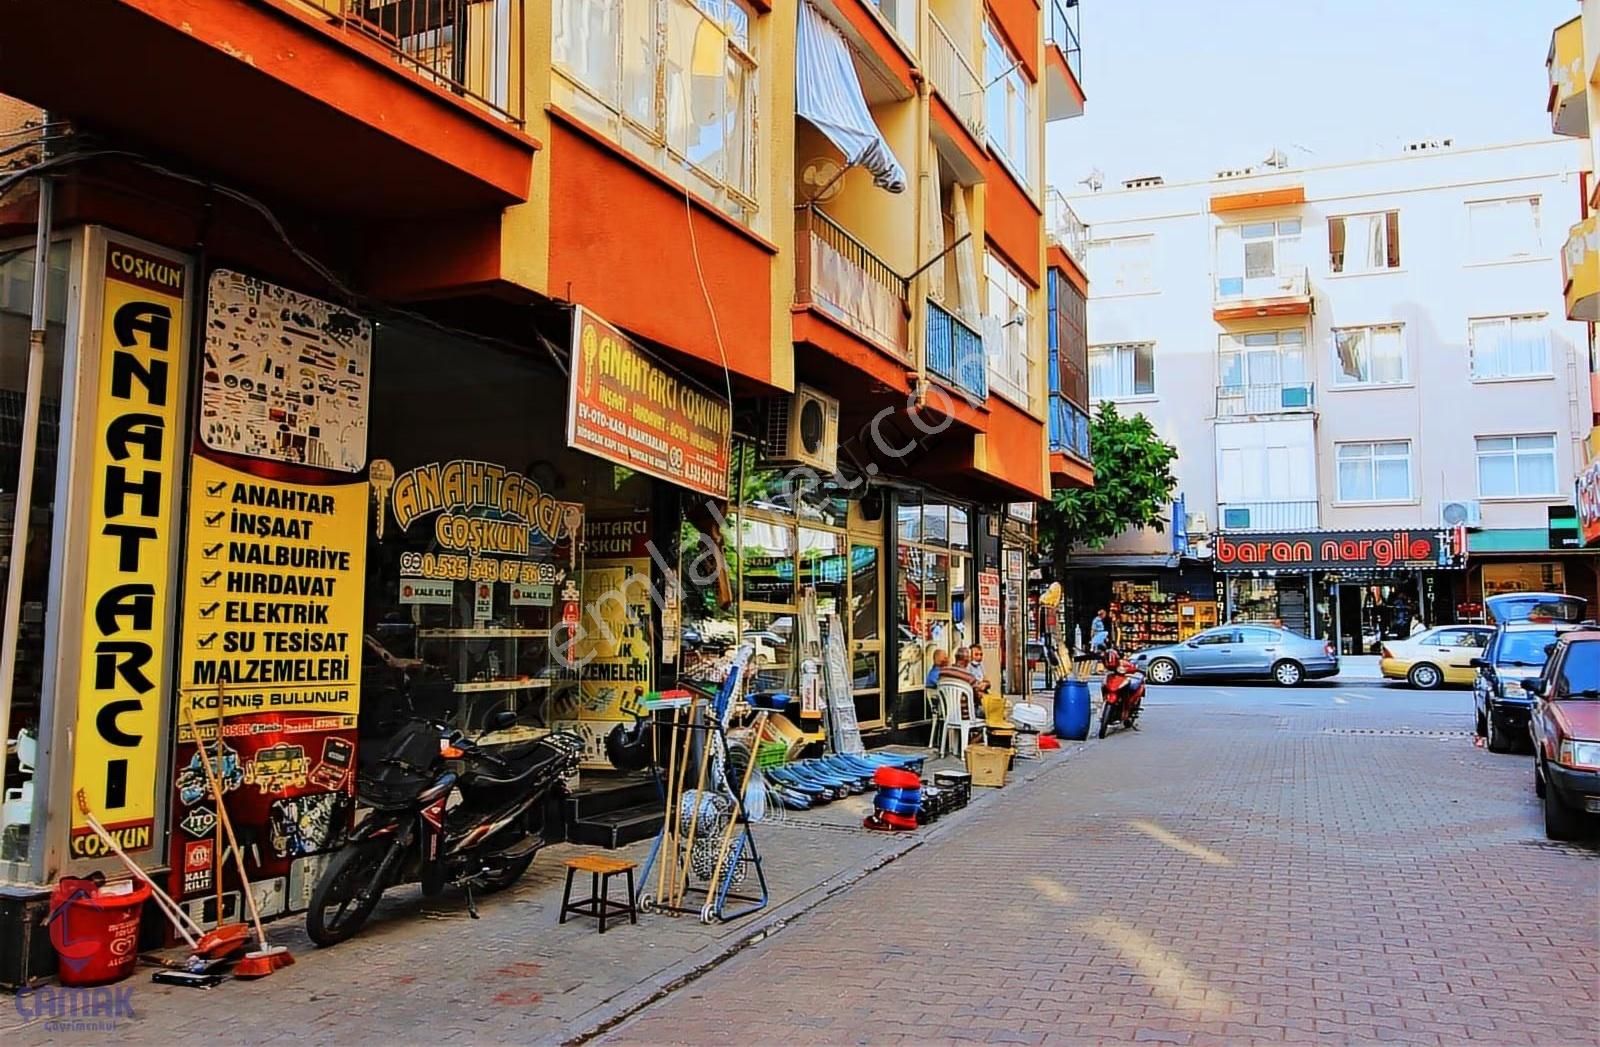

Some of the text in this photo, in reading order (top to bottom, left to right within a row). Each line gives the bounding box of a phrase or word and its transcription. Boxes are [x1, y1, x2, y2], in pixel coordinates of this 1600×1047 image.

[111, 251, 182, 288] COŞKUN
[599, 337, 722, 433] ANAHTARCI COŞKUN
[231, 483, 335, 515] ANAHTAR
[392, 460, 562, 544] ANAHTARCI
[230, 508, 313, 540] İNŞAAT
[436, 513, 529, 556] COŞKUN
[94, 301, 172, 809] ANAHTARCI
[229, 541, 350, 570] NALBURİYE
[1216, 532, 1431, 567] baran nargile
[227, 571, 336, 597] HIRDAVAT
[469, 558, 499, 582] 543
[500, 560, 520, 584] 87
[225, 600, 329, 624] ELEKTRİK
[223, 628, 349, 652] SU TESİSAT
[193, 654, 349, 684] MALZEMELERİ
[192, 691, 349, 709] KORNİŞ BULUNUR
[73, 826, 149, 855] COŞKUN
[185, 869, 212, 881] KALE
